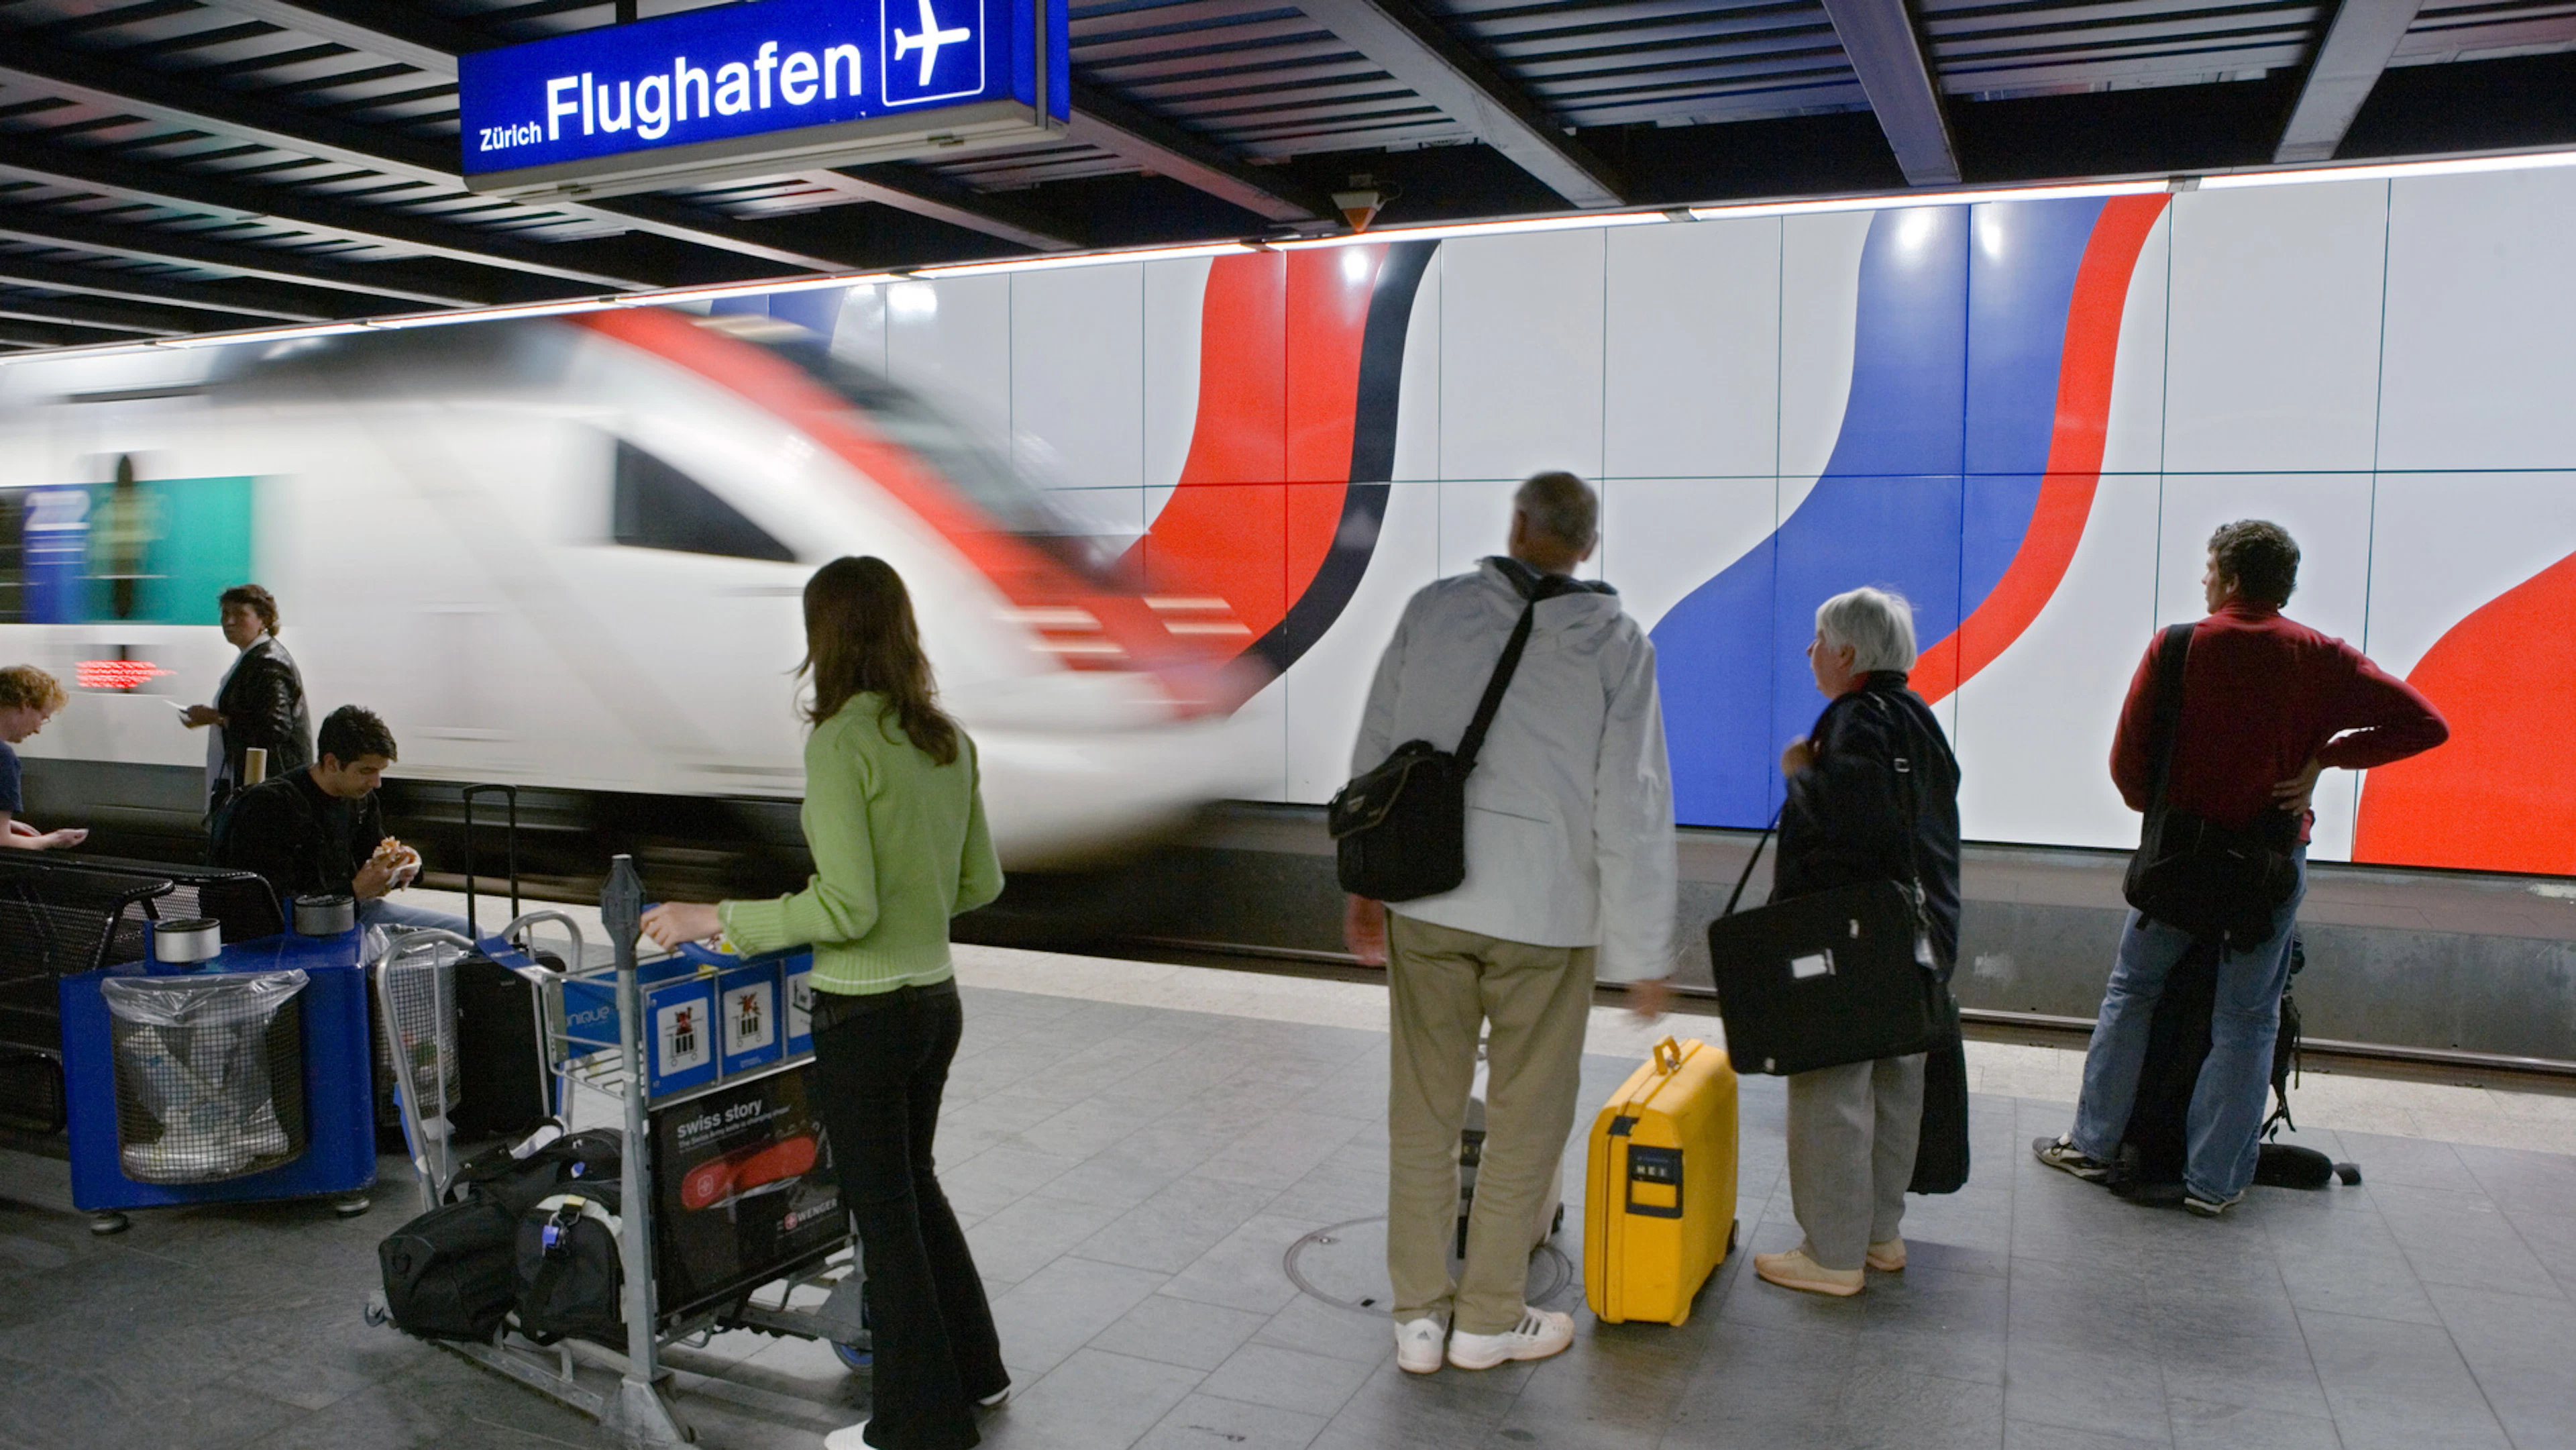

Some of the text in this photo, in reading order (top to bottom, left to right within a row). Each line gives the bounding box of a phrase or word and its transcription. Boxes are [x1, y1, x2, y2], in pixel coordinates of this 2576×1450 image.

[479, 40, 862, 152] Zürich Flughafen
[677, 1112, 721, 1139] swiss
[724, 1099, 762, 1123] story
